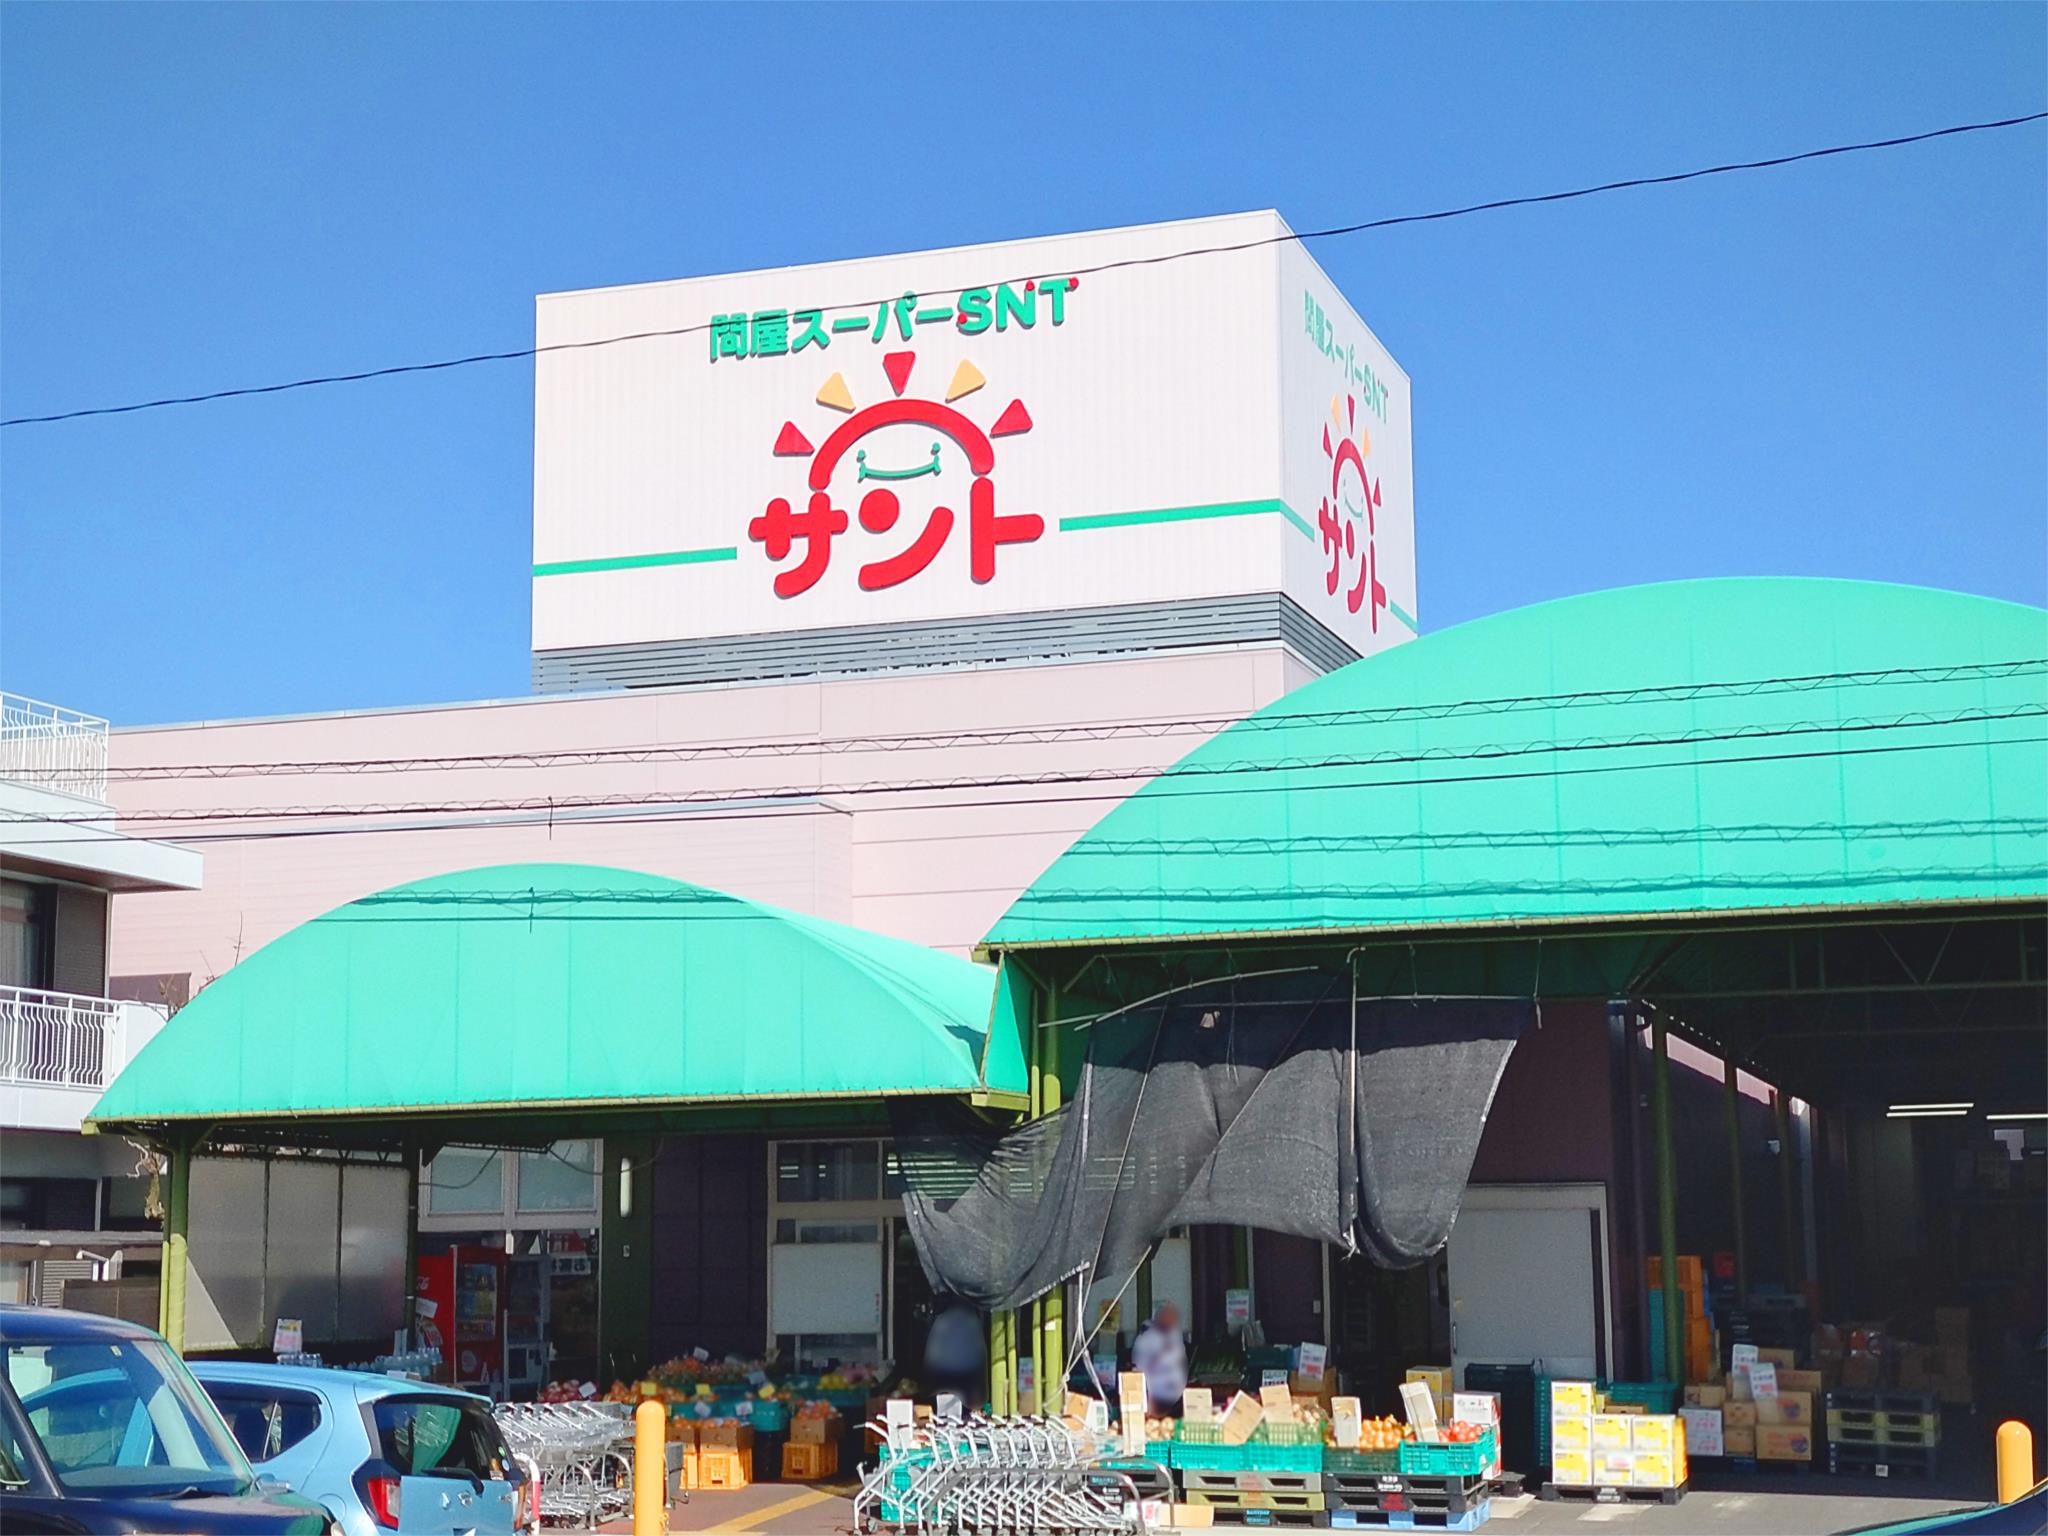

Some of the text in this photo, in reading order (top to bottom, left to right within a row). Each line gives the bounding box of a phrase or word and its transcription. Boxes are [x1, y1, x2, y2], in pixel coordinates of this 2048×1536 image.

[709, 276, 1080, 362] 問屋スーパーSNT
[748, 477, 1045, 599] サント
[1318, 495, 1387, 635] サント
